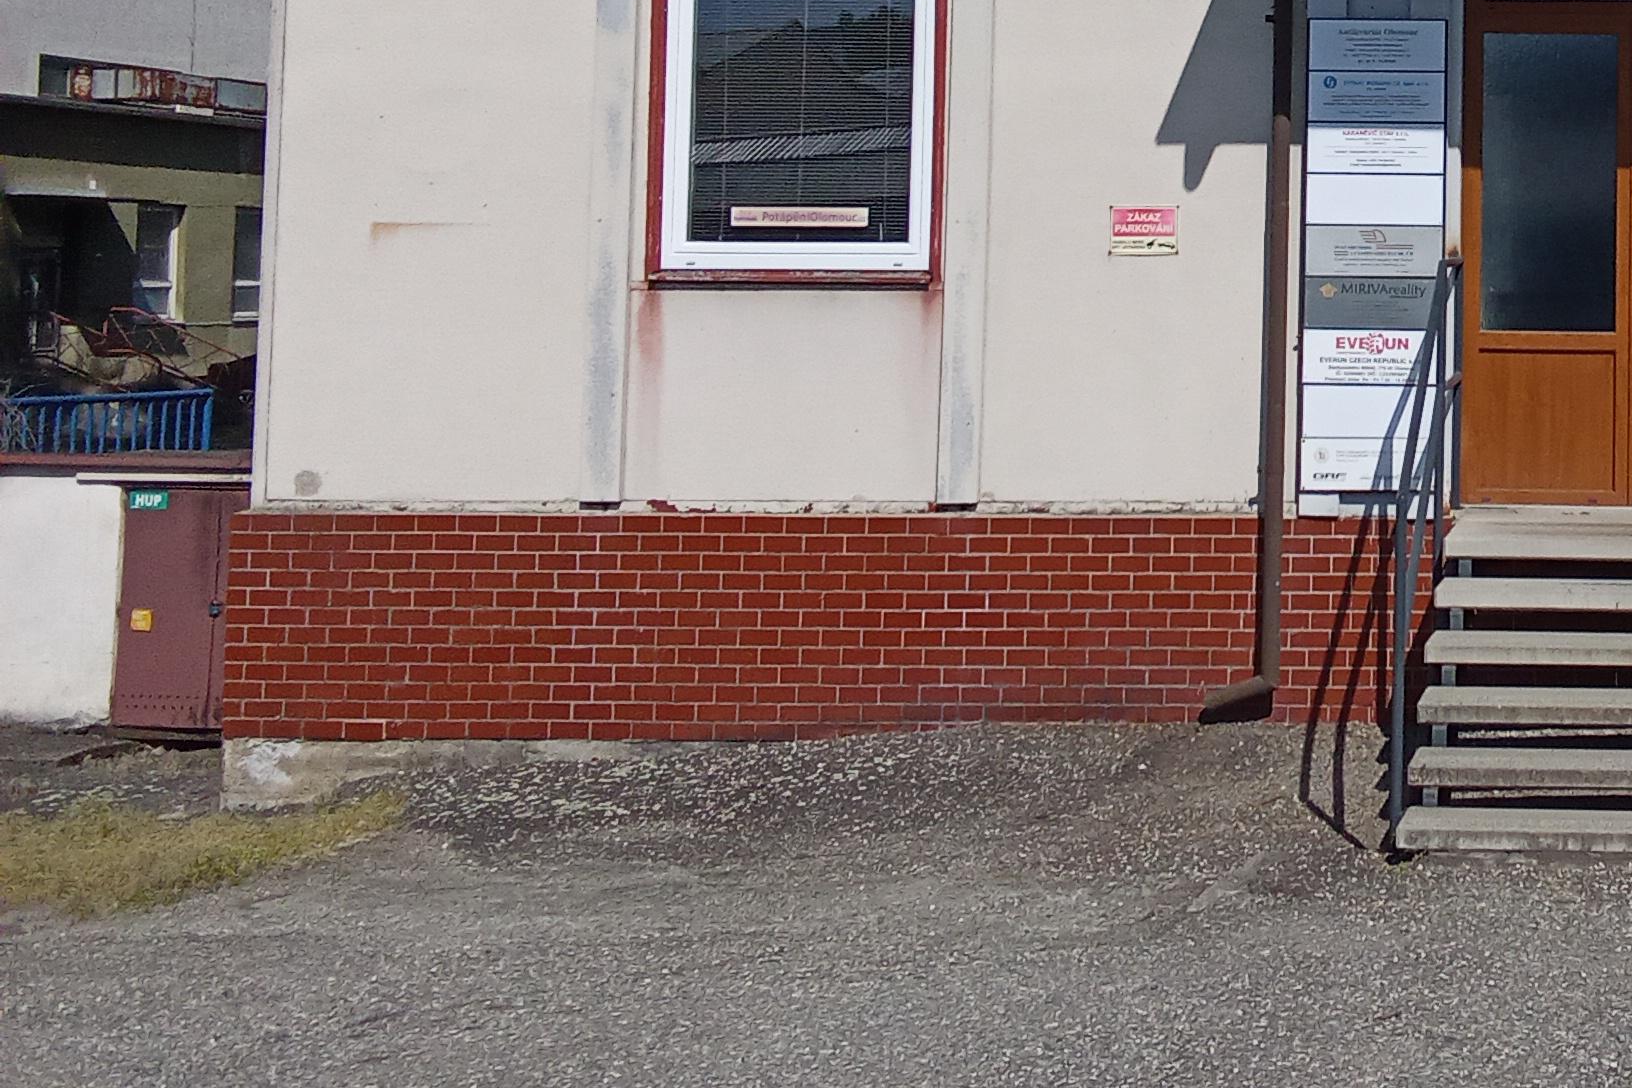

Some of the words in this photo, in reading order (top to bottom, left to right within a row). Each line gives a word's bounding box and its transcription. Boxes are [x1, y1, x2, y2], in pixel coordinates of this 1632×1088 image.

[1126, 211, 1162, 222] ZÁKAZ
[1114, 223, 1174, 233] PARKOVÁNÍ
[1341, 283, 1427, 298] MIRIVAreality
[1335, 333, 1410, 355] EVERUN
[135, 494, 163, 507] HUP
